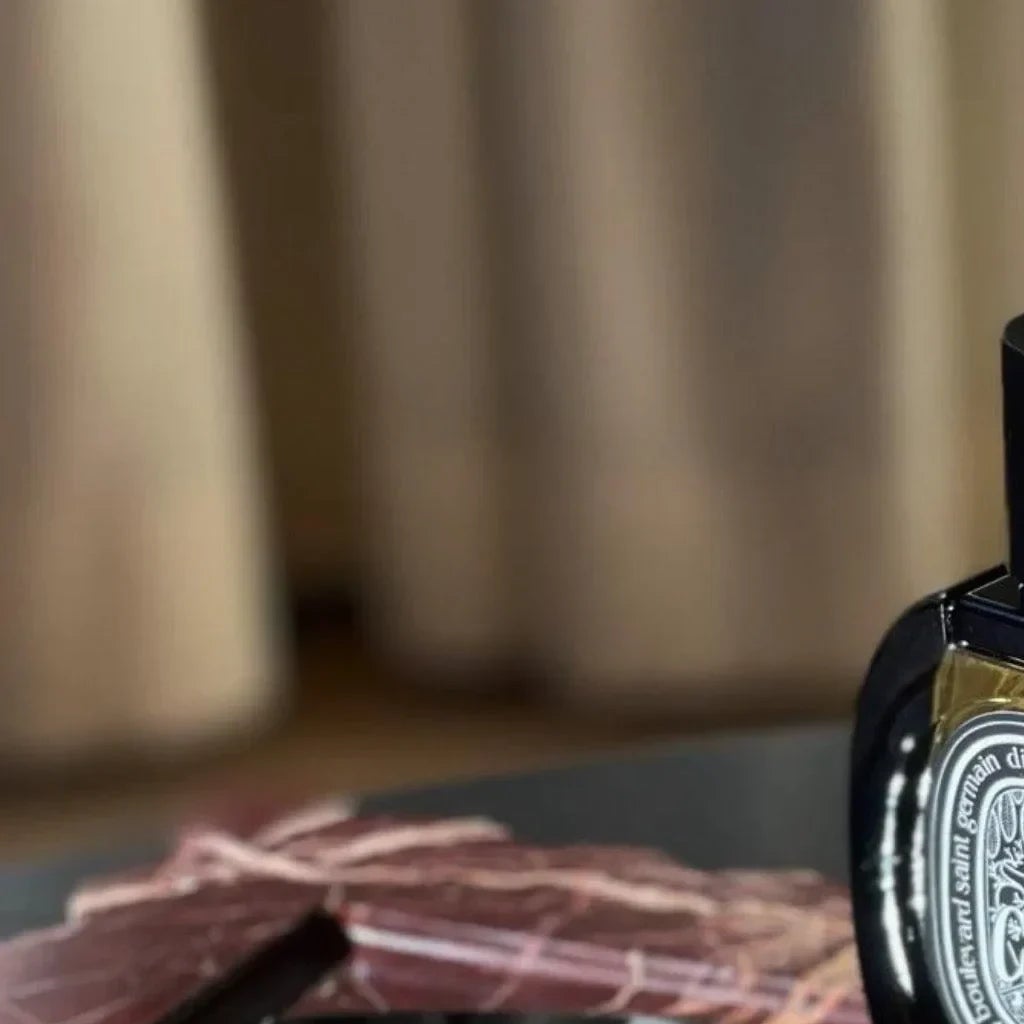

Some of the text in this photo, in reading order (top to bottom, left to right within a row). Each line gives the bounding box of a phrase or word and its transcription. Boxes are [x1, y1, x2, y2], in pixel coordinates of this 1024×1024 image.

[957, 753, 1001, 834] germain
[951, 835, 971, 896] saint
[951, 897, 991, 1024] boulevard
